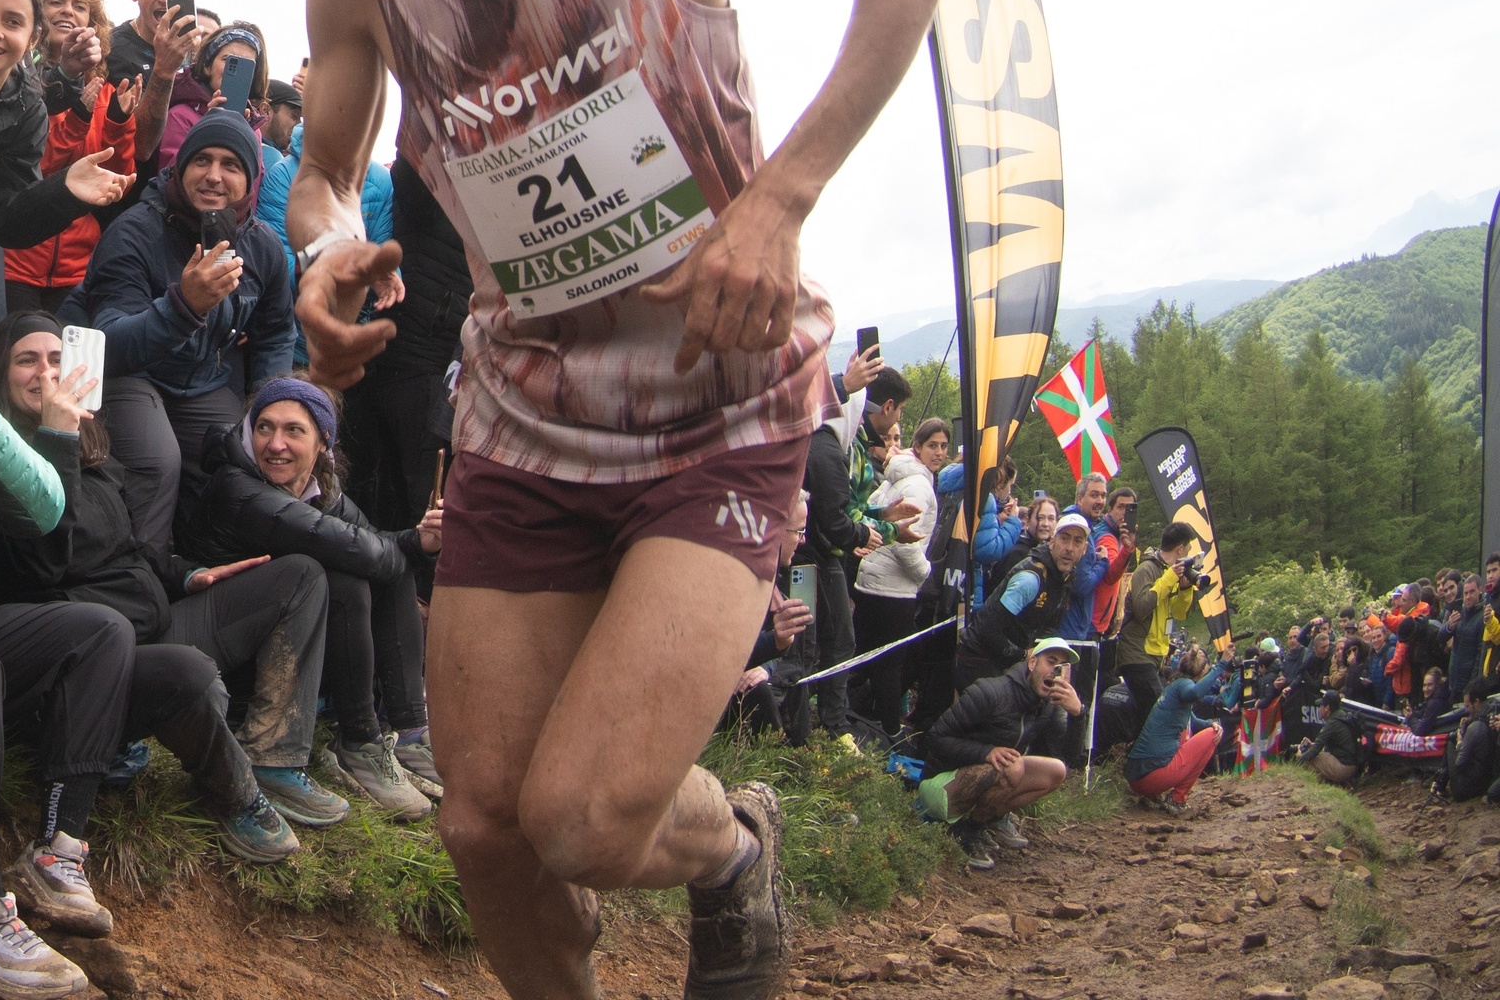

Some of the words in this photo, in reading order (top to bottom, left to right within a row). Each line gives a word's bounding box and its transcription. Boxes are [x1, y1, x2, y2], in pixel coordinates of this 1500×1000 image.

[457, 84, 628, 178] ZEGAMA-AIZKORRI
[505, 160, 535, 180] MENDI
[536, 131, 589, 167] MARATOIA
[517, 154, 597, 225] 21
[519, 188, 630, 248] ELHOUSINE
[509, 199, 684, 290] ZEGAMA
[565, 262, 640, 301] SALOMON
[1301, 705, 1326, 725] SAL
[44, 782, 65, 839] SALOMON
